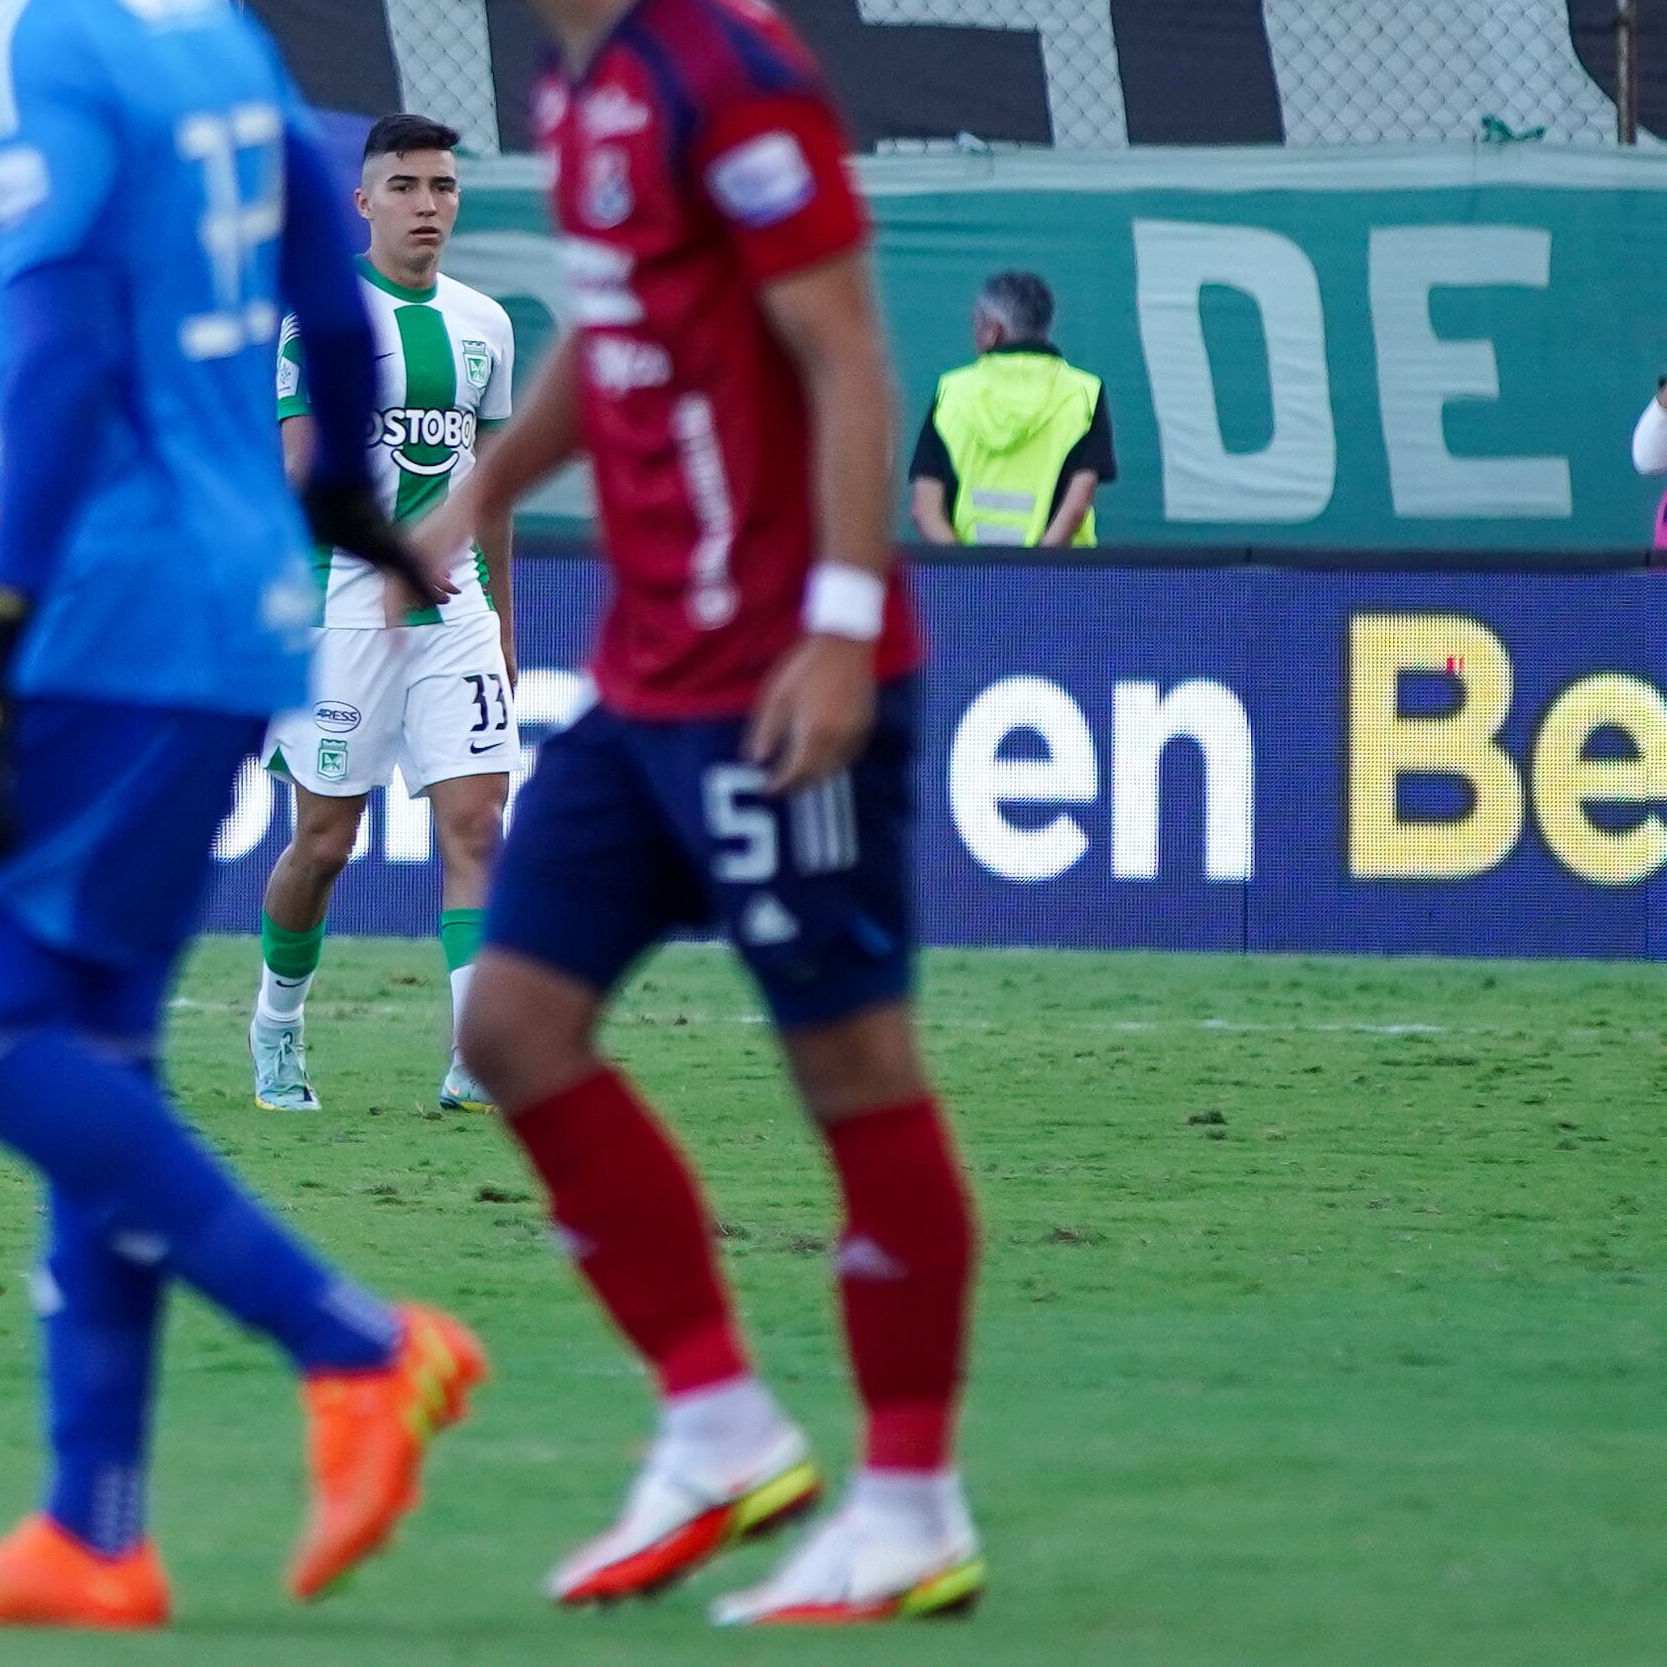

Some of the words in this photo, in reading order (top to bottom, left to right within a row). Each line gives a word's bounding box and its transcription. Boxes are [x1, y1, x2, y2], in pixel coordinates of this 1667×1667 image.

[1132, 218, 1573, 525] DE
[463, 674, 508, 732] 33
[949, 675, 1255, 881] en
